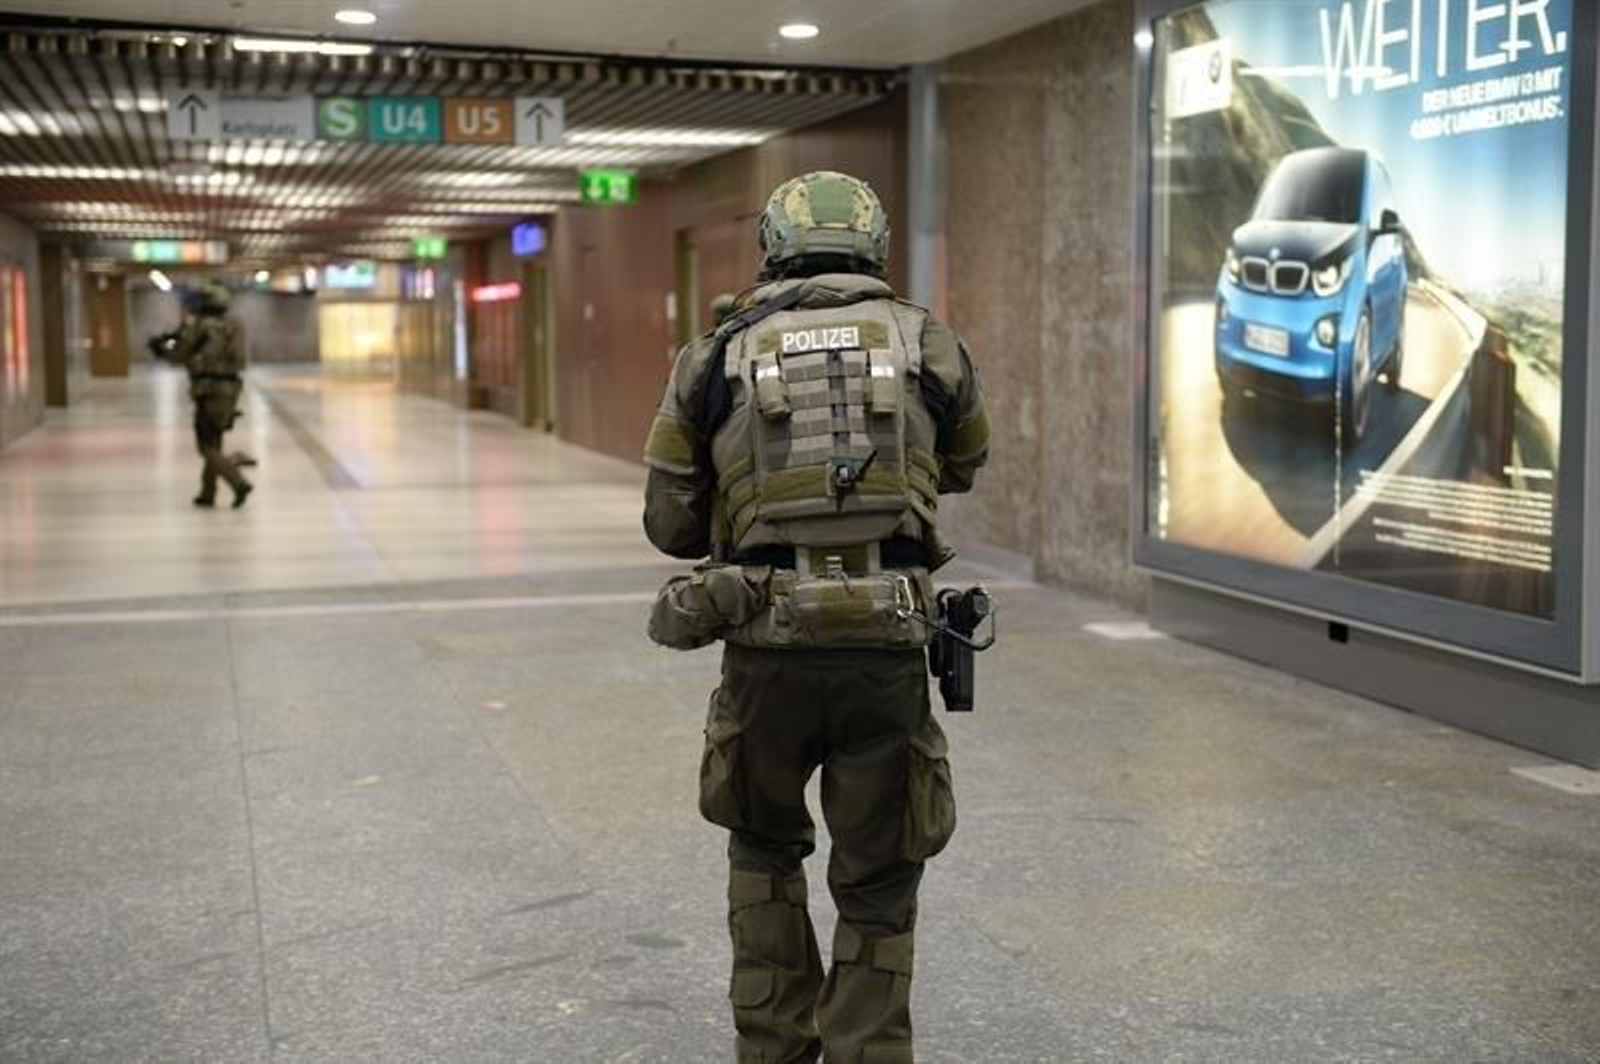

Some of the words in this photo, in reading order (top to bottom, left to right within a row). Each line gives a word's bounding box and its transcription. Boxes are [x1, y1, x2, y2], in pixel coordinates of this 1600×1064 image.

[325, 97, 358, 138] S
[381, 103, 427, 135] U4
[456, 105, 502, 136] U5
[782, 326, 860, 353] POLIZEI
